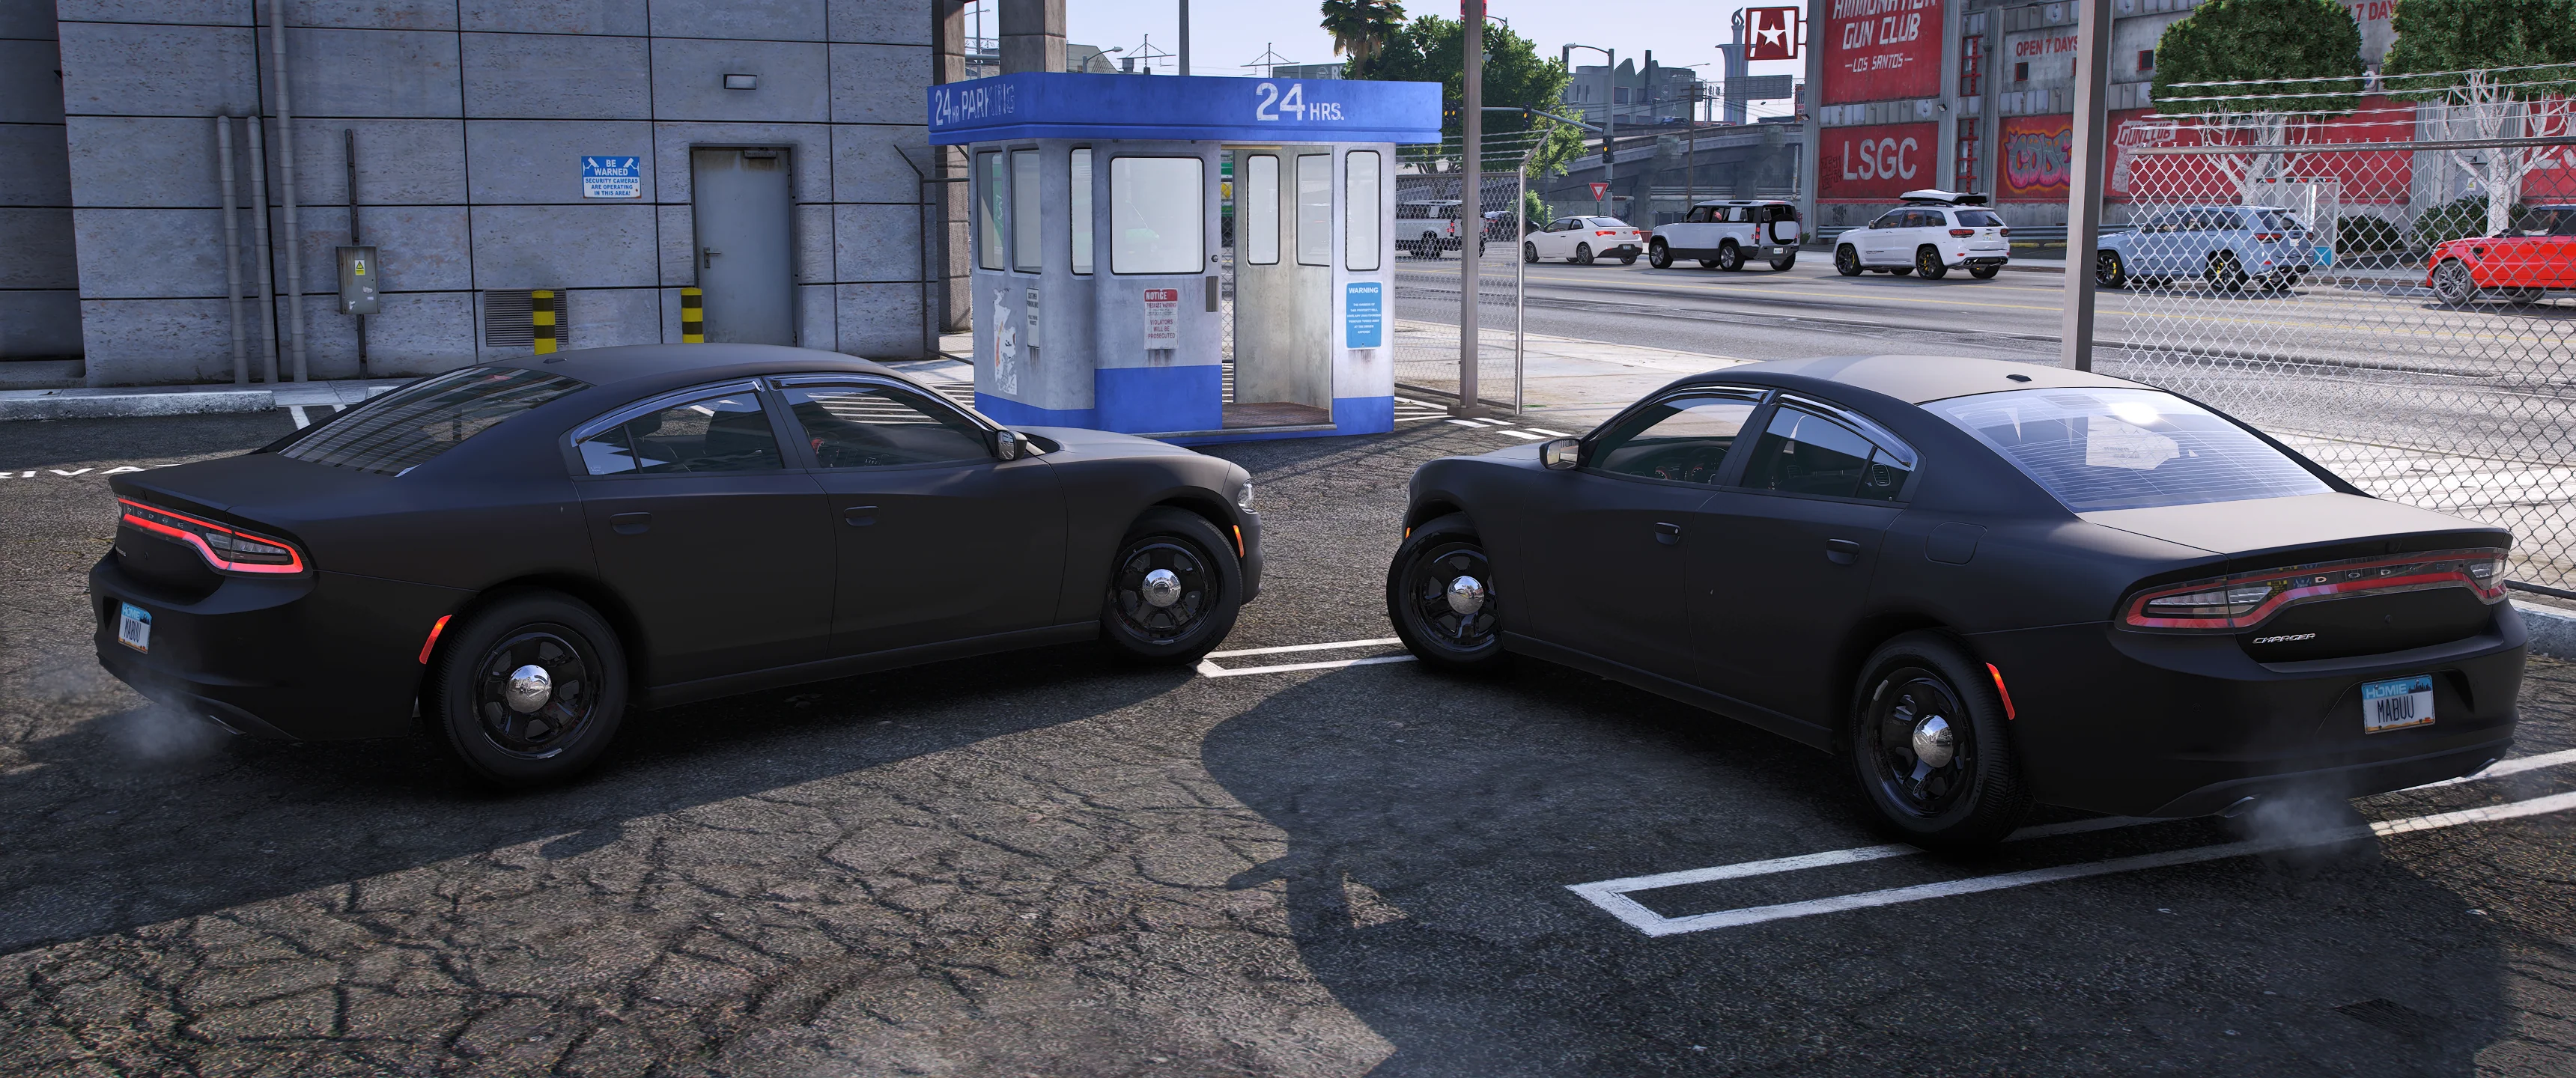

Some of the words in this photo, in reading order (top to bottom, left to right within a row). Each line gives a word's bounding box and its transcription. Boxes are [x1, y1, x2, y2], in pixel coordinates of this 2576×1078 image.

[1842, 19, 1874, 50] GUN
[1879, 13, 1922, 45] CLUB
[2016, 39, 2044, 57] OPEN
[2045, 38, 2052, 54] 7
[1852, 56, 1868, 73] LOS
[1871, 53, 1904, 70] SANTOS
[935, 88, 952, 126] 24
[952, 105, 960, 124] HR
[962, 84, 1015, 120] PARKING
[1256, 82, 1306, 121] 24
[1310, 103, 1345, 121] HRS.
[1843, 137, 1919, 180] LSGC
[1146, 291, 1167, 300] NOTICE
[2253, 633, 2316, 645] CHARGER
[2366, 683, 2408, 698] HOMIE
[2377, 695, 2414, 723] MABUU
